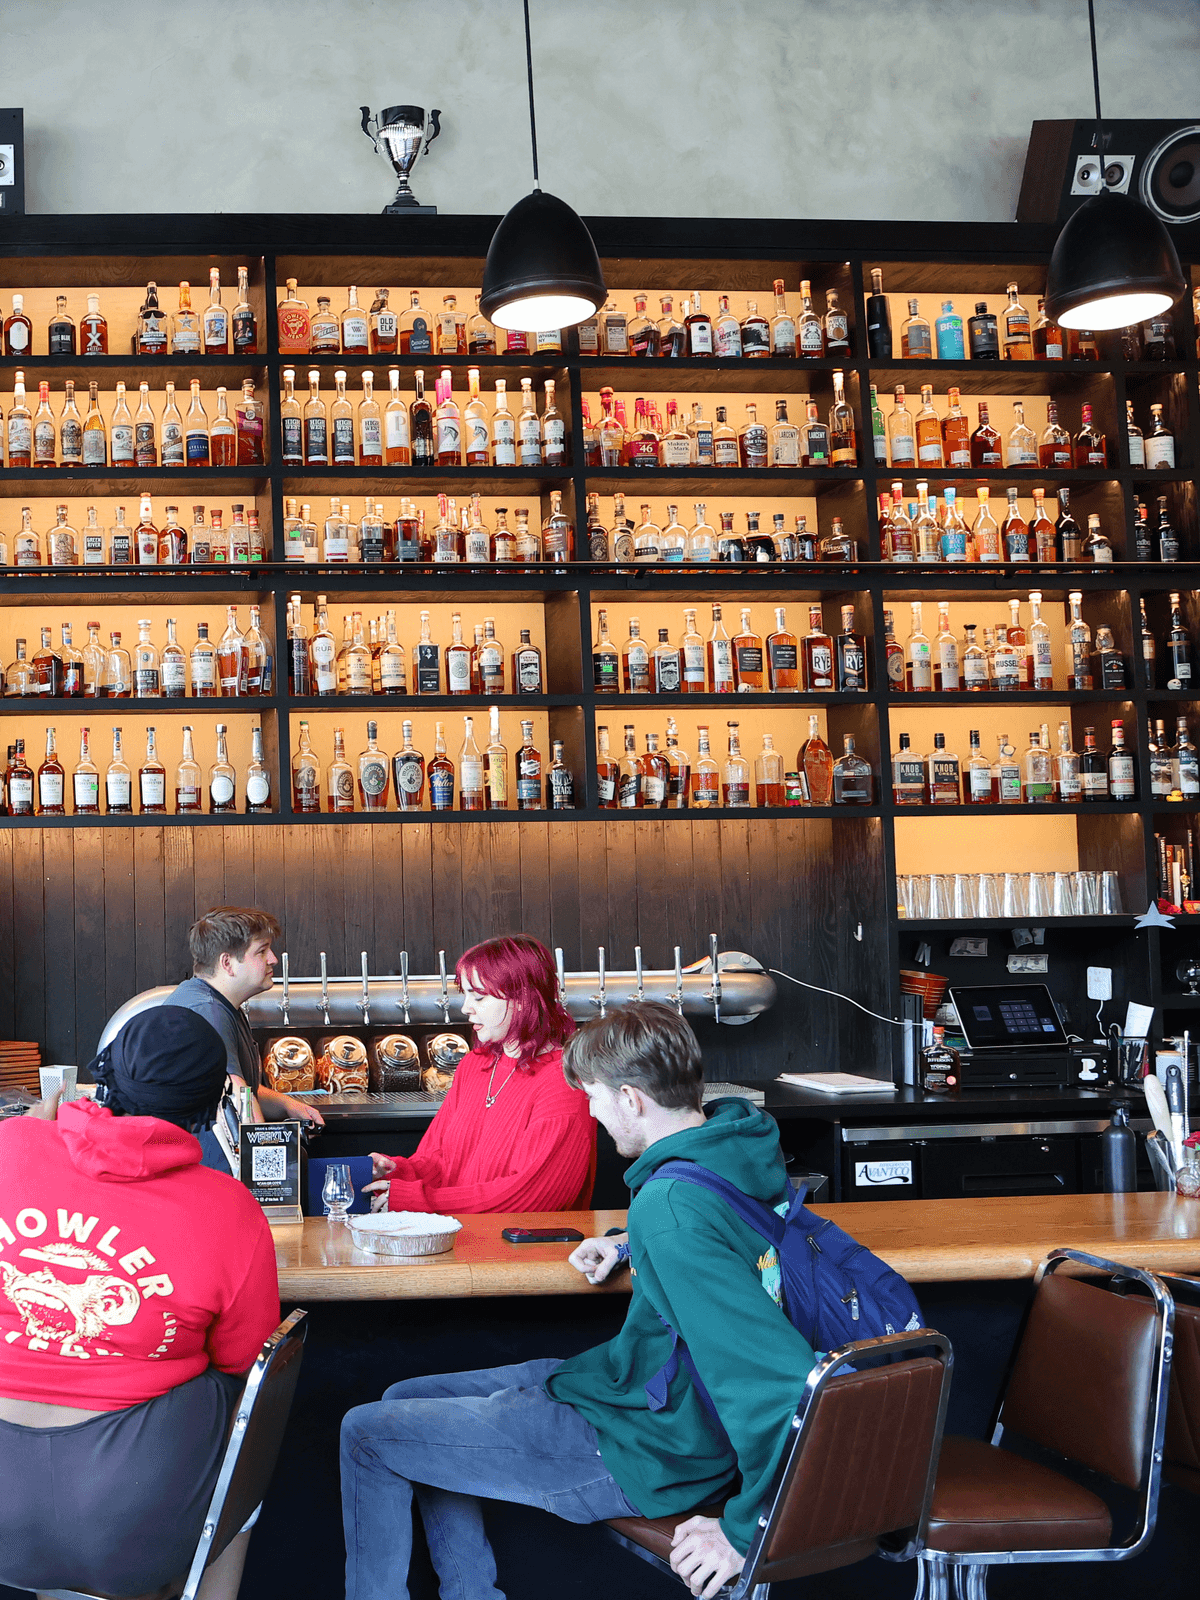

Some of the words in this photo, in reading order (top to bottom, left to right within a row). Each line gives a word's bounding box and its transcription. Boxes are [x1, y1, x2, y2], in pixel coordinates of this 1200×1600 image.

[284, 312, 306, 323] HOWLER
[640, 443, 654, 454] 46
[814, 656, 830, 670] RYE
[846, 656, 863, 670] RYE
[900, 764, 920, 773] KNOB
[934, 764, 954, 772] KNOB
[246, 1131, 293, 1144] WEEKLY
[858, 1164, 910, 1179] AVANTCO
[147, 1312, 177, 1358] SPIRIT
